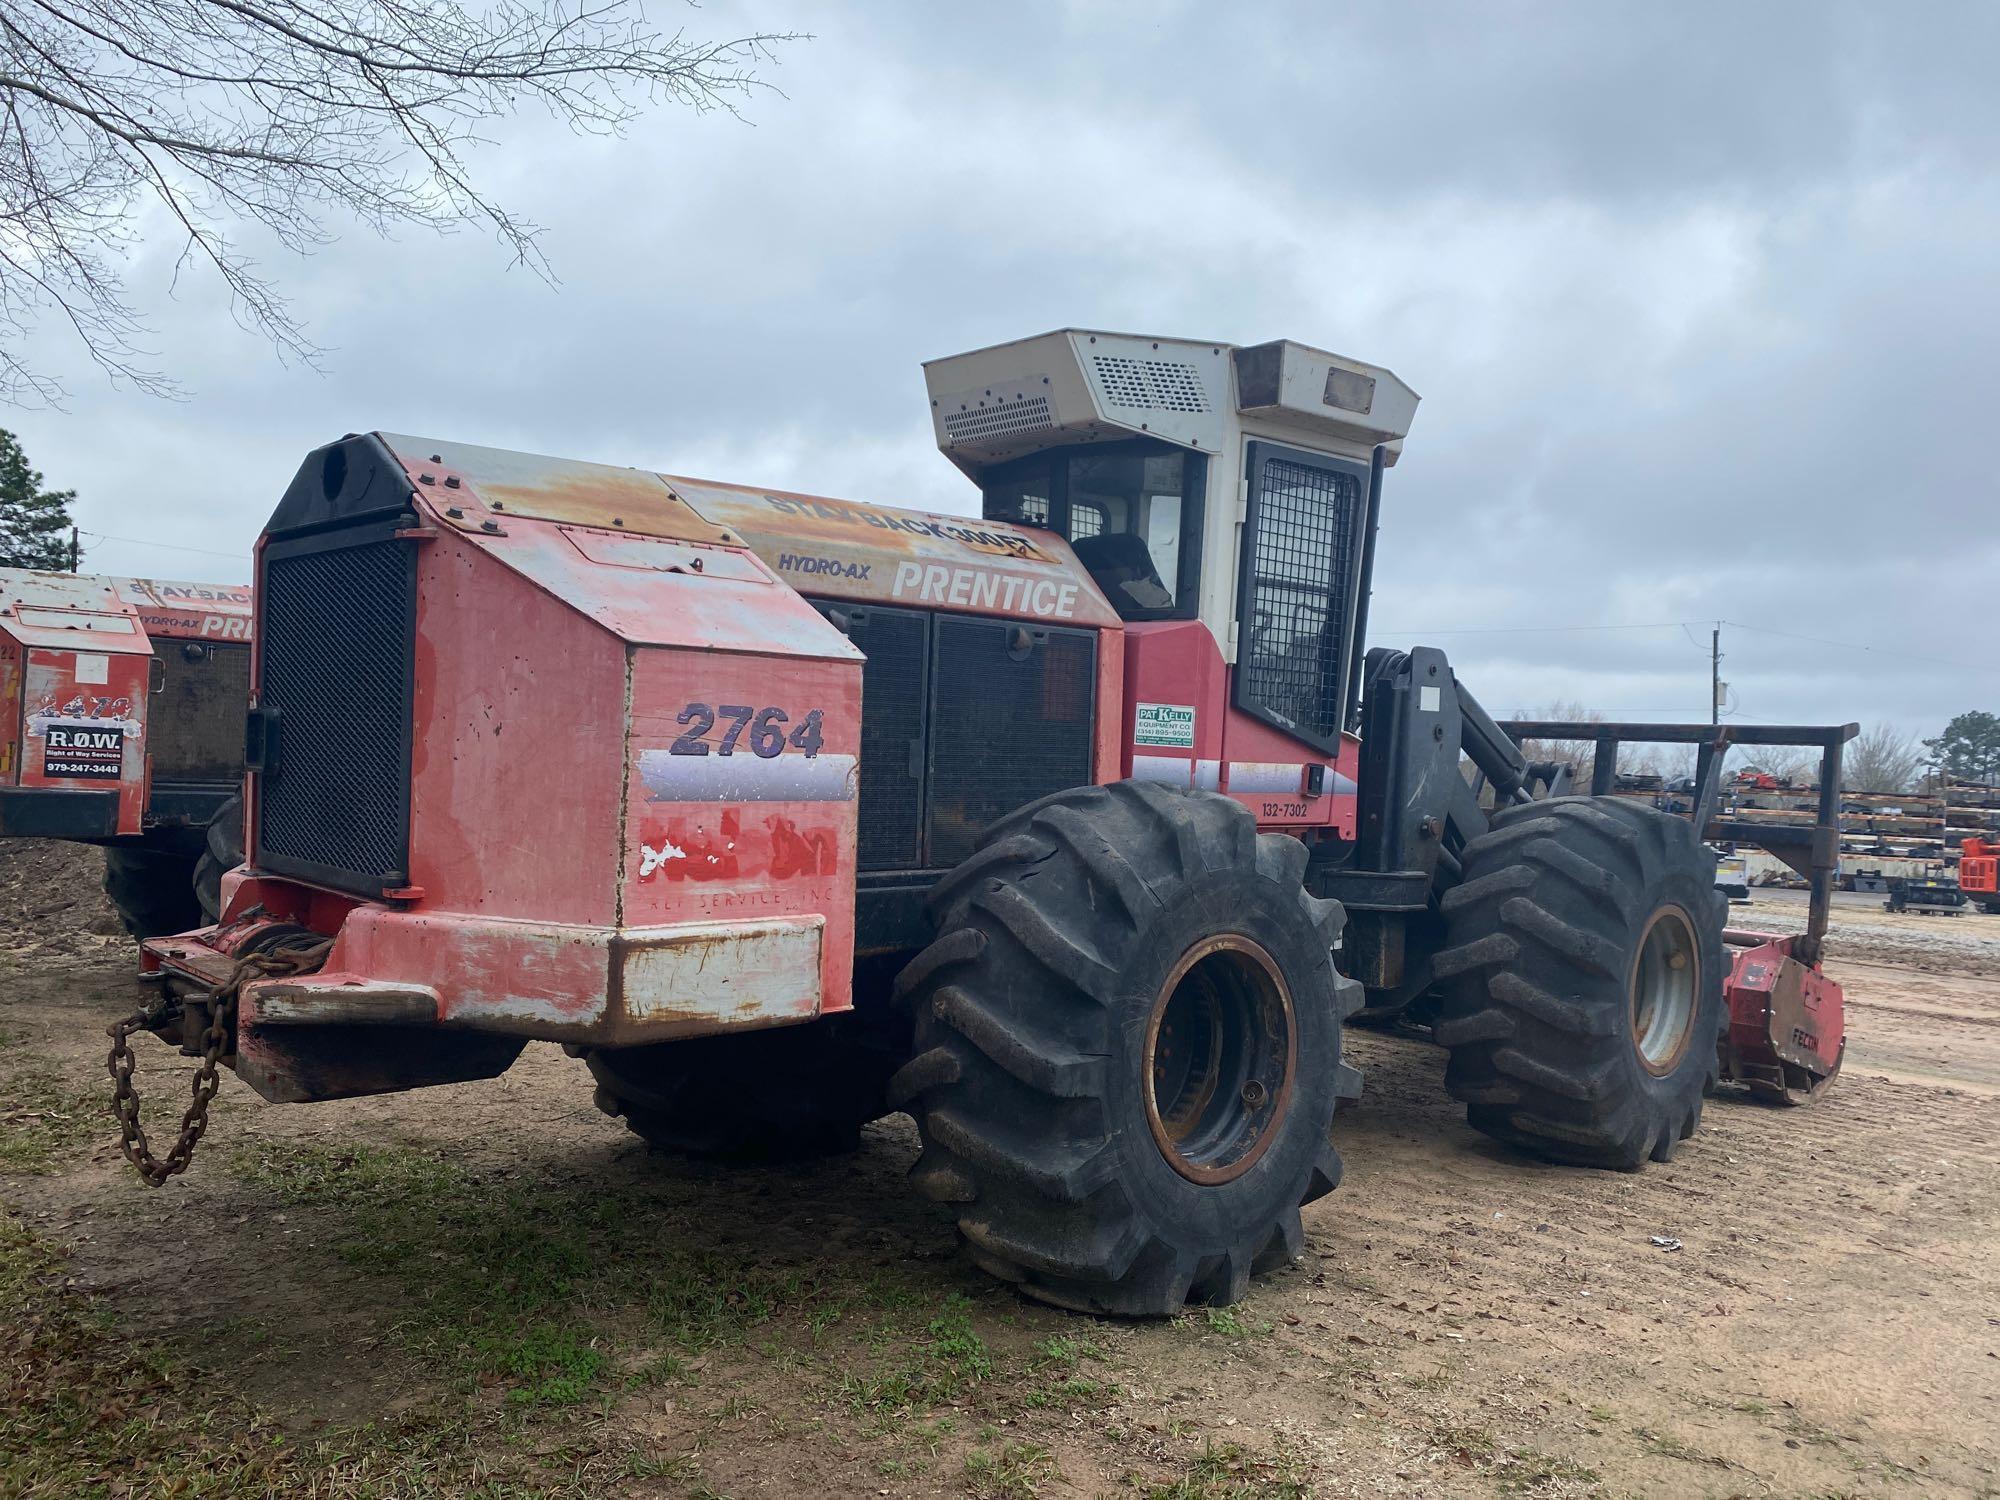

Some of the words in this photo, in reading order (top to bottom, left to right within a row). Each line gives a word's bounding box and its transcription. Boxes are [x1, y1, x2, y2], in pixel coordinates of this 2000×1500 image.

[763, 494, 858, 522] STAY
[853, 510, 951, 540] BACK
[778, 553, 871, 581] HYDRO-AX
[891, 560, 1079, 618] PRENTICE
[198, 590, 252, 604] BAC
[1140, 709, 1157, 719] PAT
[1157, 707, 1191, 722] KELLY
[669, 702, 824, 759] 2764
[1138, 722, 1178, 730] EQUIPMENT
[46, 749, 65, 758] Right
[66, 749, 75, 757] of
[75, 751, 91, 759] Way
[91, 751, 121, 759] Services
[47, 763, 118, 773] 979-247-3448
[1262, 802, 1307, 818] 132-7302
